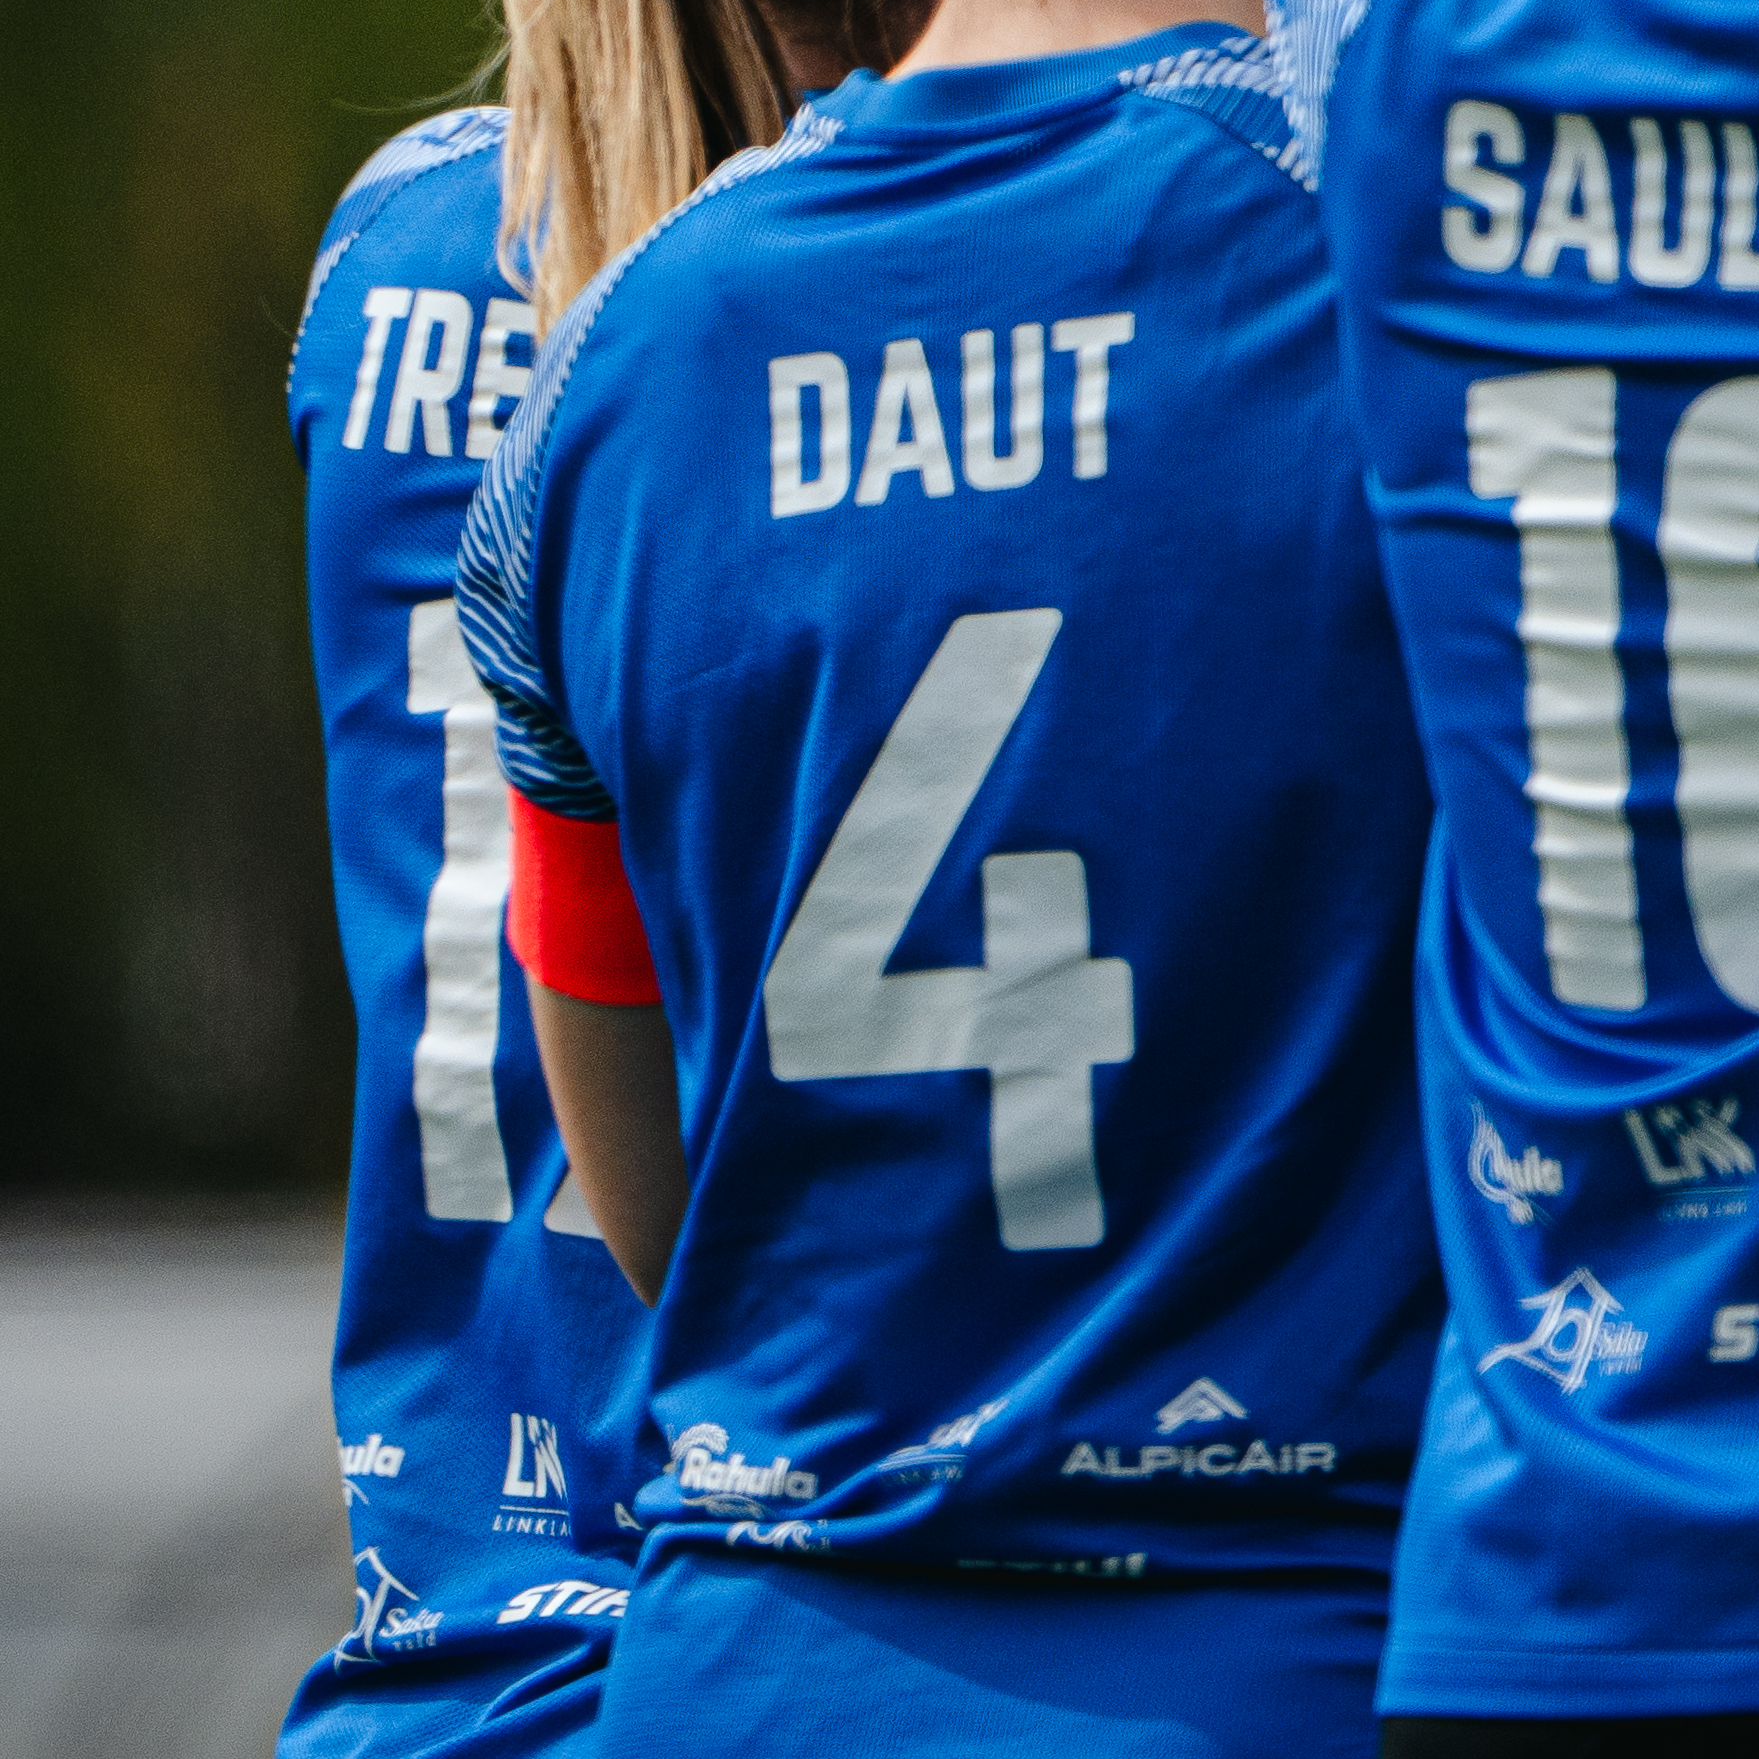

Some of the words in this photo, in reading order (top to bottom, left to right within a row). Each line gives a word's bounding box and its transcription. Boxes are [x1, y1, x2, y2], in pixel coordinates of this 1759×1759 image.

[768, 312, 1134, 518] DAUT
[764, 607, 1134, 1250] 4
[338, 1433, 406, 1478] ula
[679, 1447, 819, 1501] Rahula
[1060, 1440, 1337, 1477] ALPICAIR
